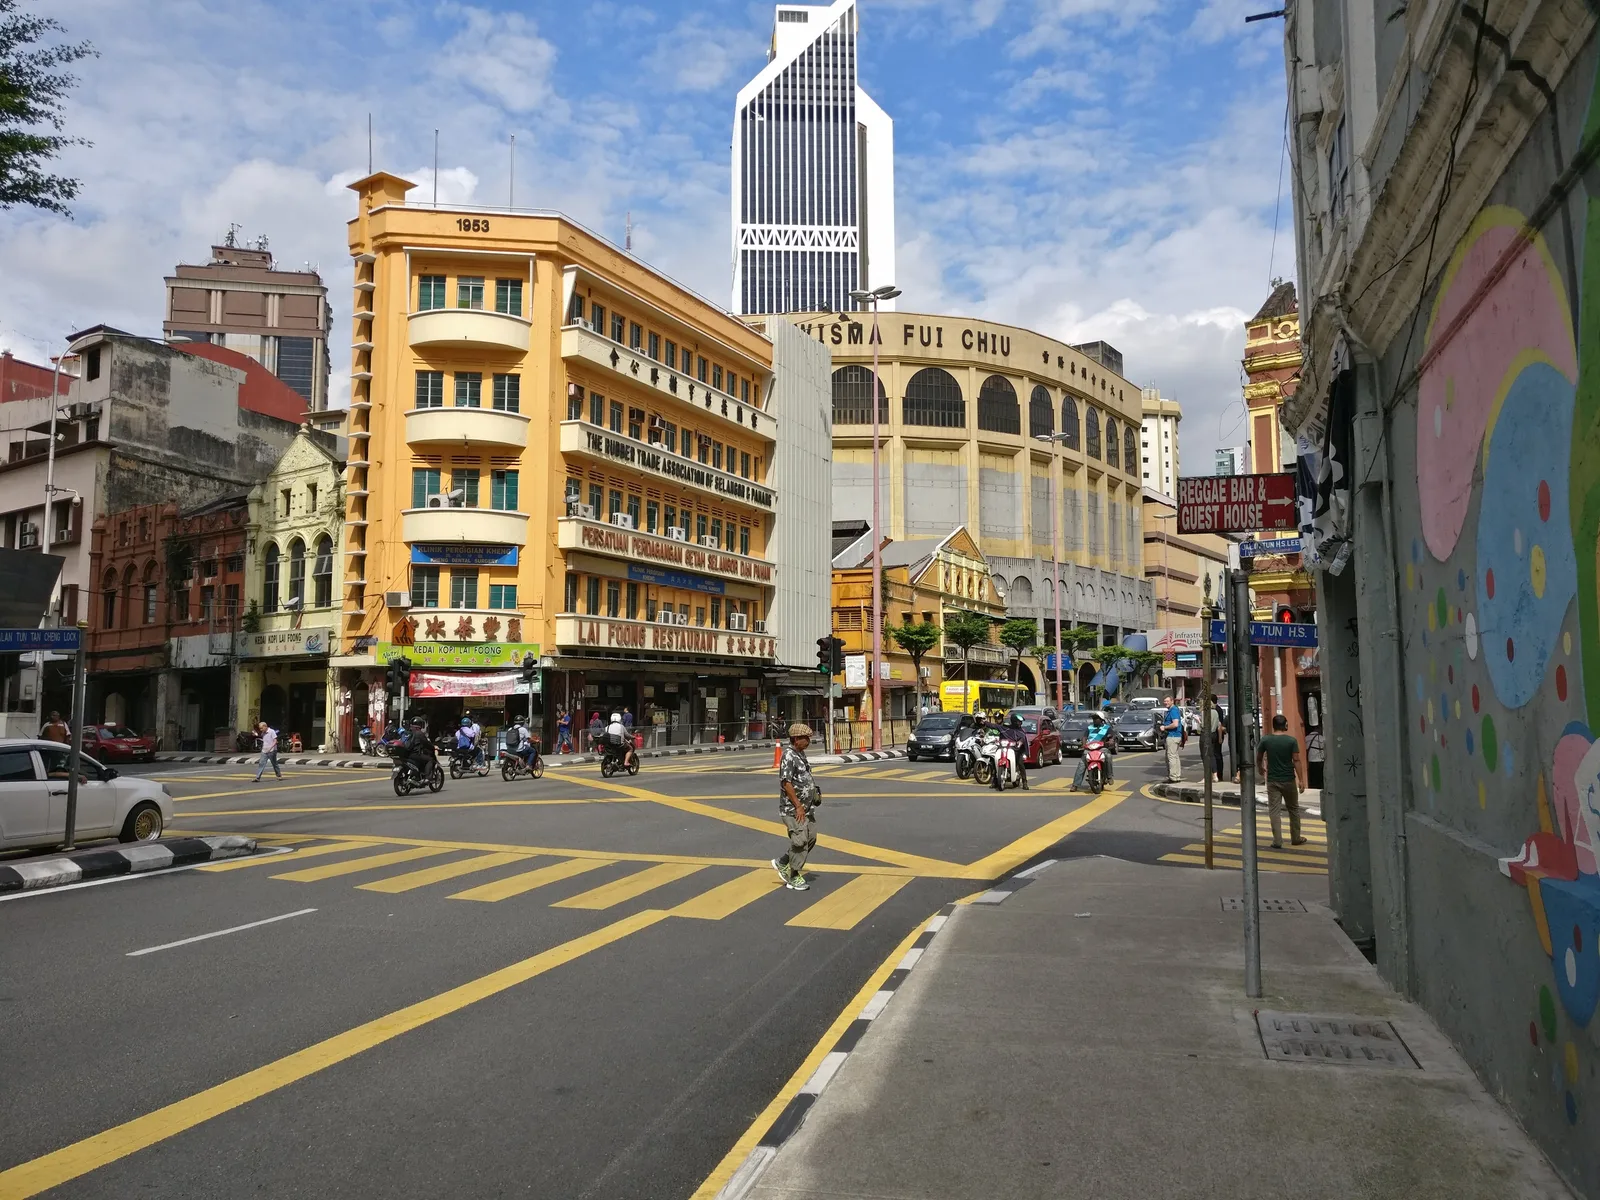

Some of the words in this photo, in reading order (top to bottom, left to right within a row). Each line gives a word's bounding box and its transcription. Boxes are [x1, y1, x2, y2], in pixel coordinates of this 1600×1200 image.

[456, 218, 490, 233] 1953
[903, 324, 943, 348] FUI
[961, 328, 1011, 357] CHIU
[587, 431, 603, 452] THE
[604, 437, 636, 463] RUBBER
[636, 448, 661, 471] TRADE
[661, 457, 705, 486] ASSOCIATION
[705, 472, 714, 488] OF
[714, 476, 745, 499] SELANGOR
[1180, 478, 1227, 504] REGGAE
[1230, 477, 1254, 502] BAR
[1258, 477, 1266, 501] &
[1181, 505, 1220, 530] GUEST
[1223, 503, 1263, 529] HOUSE
[1275, 519, 1287, 527] 10M
[582, 525, 629, 555] PERSATUAN
[631, 536, 683, 565] PERDAGANGAN
[684, 549, 706, 568] GETAH
[708, 553, 738, 575] SELANGOR
[740, 560, 752, 580] DAN
[1263, 541, 1275, 549] TUN
[16, 632, 27, 642] TUN
[30, 632, 41, 642] TAN
[44, 632, 61, 642] CHENG
[63, 632, 77, 642] LOCK
[254, 635, 267, 645] KEDAI
[267, 634, 278, 643] KOPI
[278, 634, 286, 643] LAI
[287, 632, 302, 642] FOONG
[578, 619, 601, 645] LAI
[607, 623, 647, 648] FOONG
[652, 625, 719, 654] RESTAURANT
[1262, 625, 1283, 637] TUN
[1288, 627, 1308, 638] H.S.
[414, 646, 435, 654] KEDAI
[439, 646, 456, 654] KOPI
[459, 646, 471, 654] LAI
[474, 646, 502, 655] FOONG
